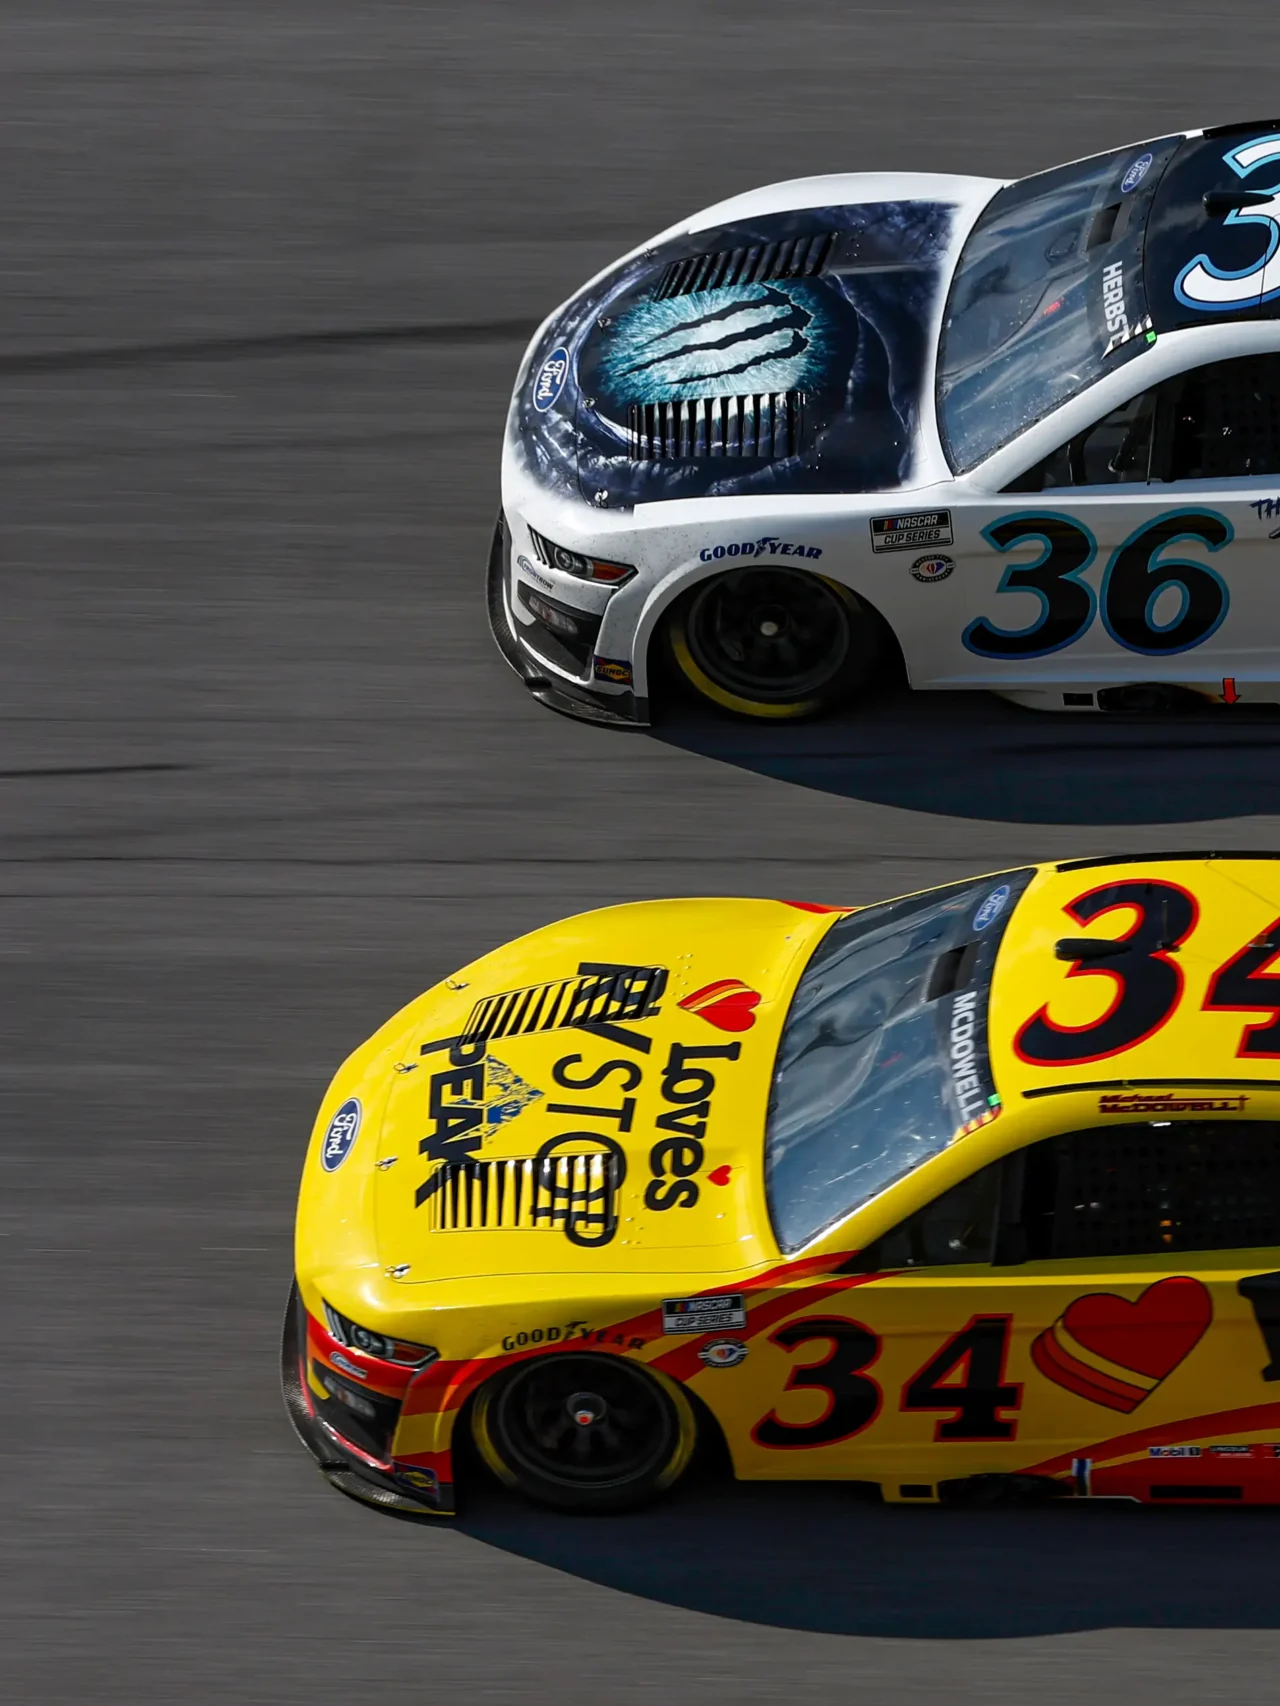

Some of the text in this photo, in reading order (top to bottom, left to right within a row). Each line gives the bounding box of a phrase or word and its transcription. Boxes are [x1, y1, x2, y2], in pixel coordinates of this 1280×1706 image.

[1123, 155, 1150, 189] Ford
[535, 353, 567, 406] Ford
[884, 530, 941, 544] CUP SERIES
[896, 515, 938, 529] NASCAR
[700, 540, 823, 562] GOODYEAR
[962, 506, 1235, 660] 36
[951, 991, 984, 1122] MCDOWELL
[323, 1105, 360, 1166] Ford
[414, 1036, 487, 1209] PEAK
[697, 1312, 734, 1325] SERIES
[502, 1326, 646, 1350] GOODYEAR
[750, 1313, 1024, 1451] 34
[1149, 1447, 1188, 1457] Mobil
